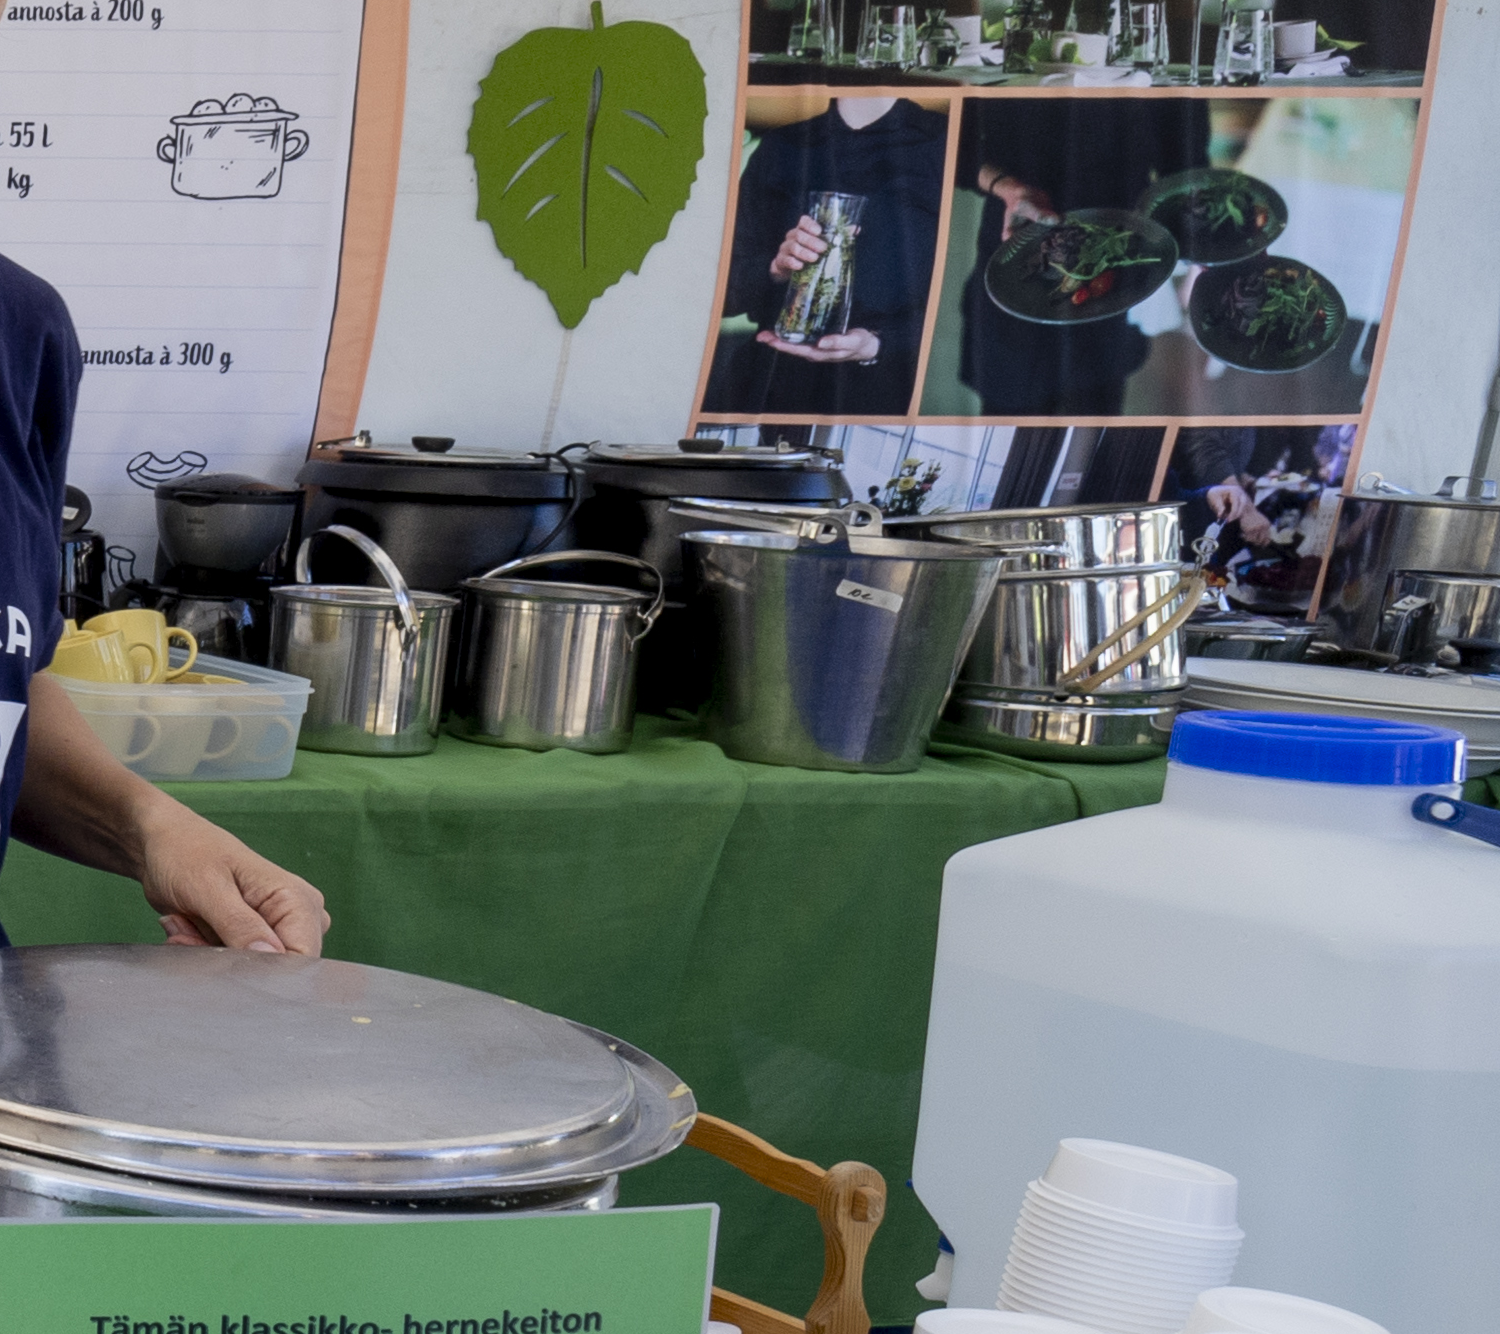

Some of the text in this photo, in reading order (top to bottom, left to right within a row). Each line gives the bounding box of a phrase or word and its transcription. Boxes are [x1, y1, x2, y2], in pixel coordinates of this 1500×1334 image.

[7, 0, 87, 22] annosta
[150, 7, 165, 31] g
[9, 121, 36, 148] 55
[6, 166, 33, 199] kg
[79, 344, 156, 366] annosta
[177, 342, 215, 366] 300
[219, 351, 233, 375] g
